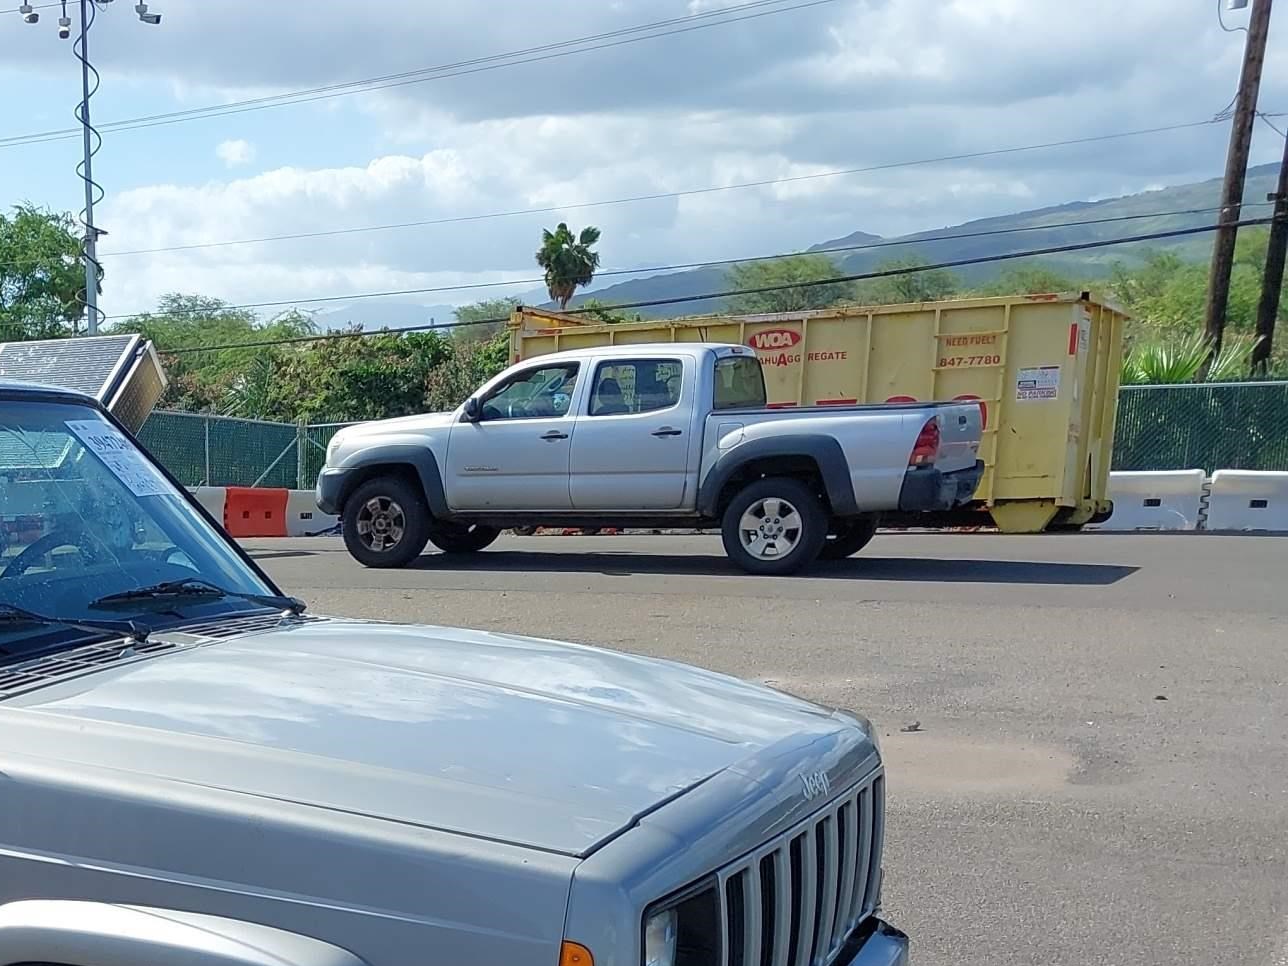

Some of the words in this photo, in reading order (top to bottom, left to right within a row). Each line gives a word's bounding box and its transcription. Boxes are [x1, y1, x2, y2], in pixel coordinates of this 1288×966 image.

[755, 332, 793, 348] WOA
[945, 336, 968, 346] NEED
[939, 354, 1001, 367] 847-7780
[798, 771, 830, 799] Jeep
